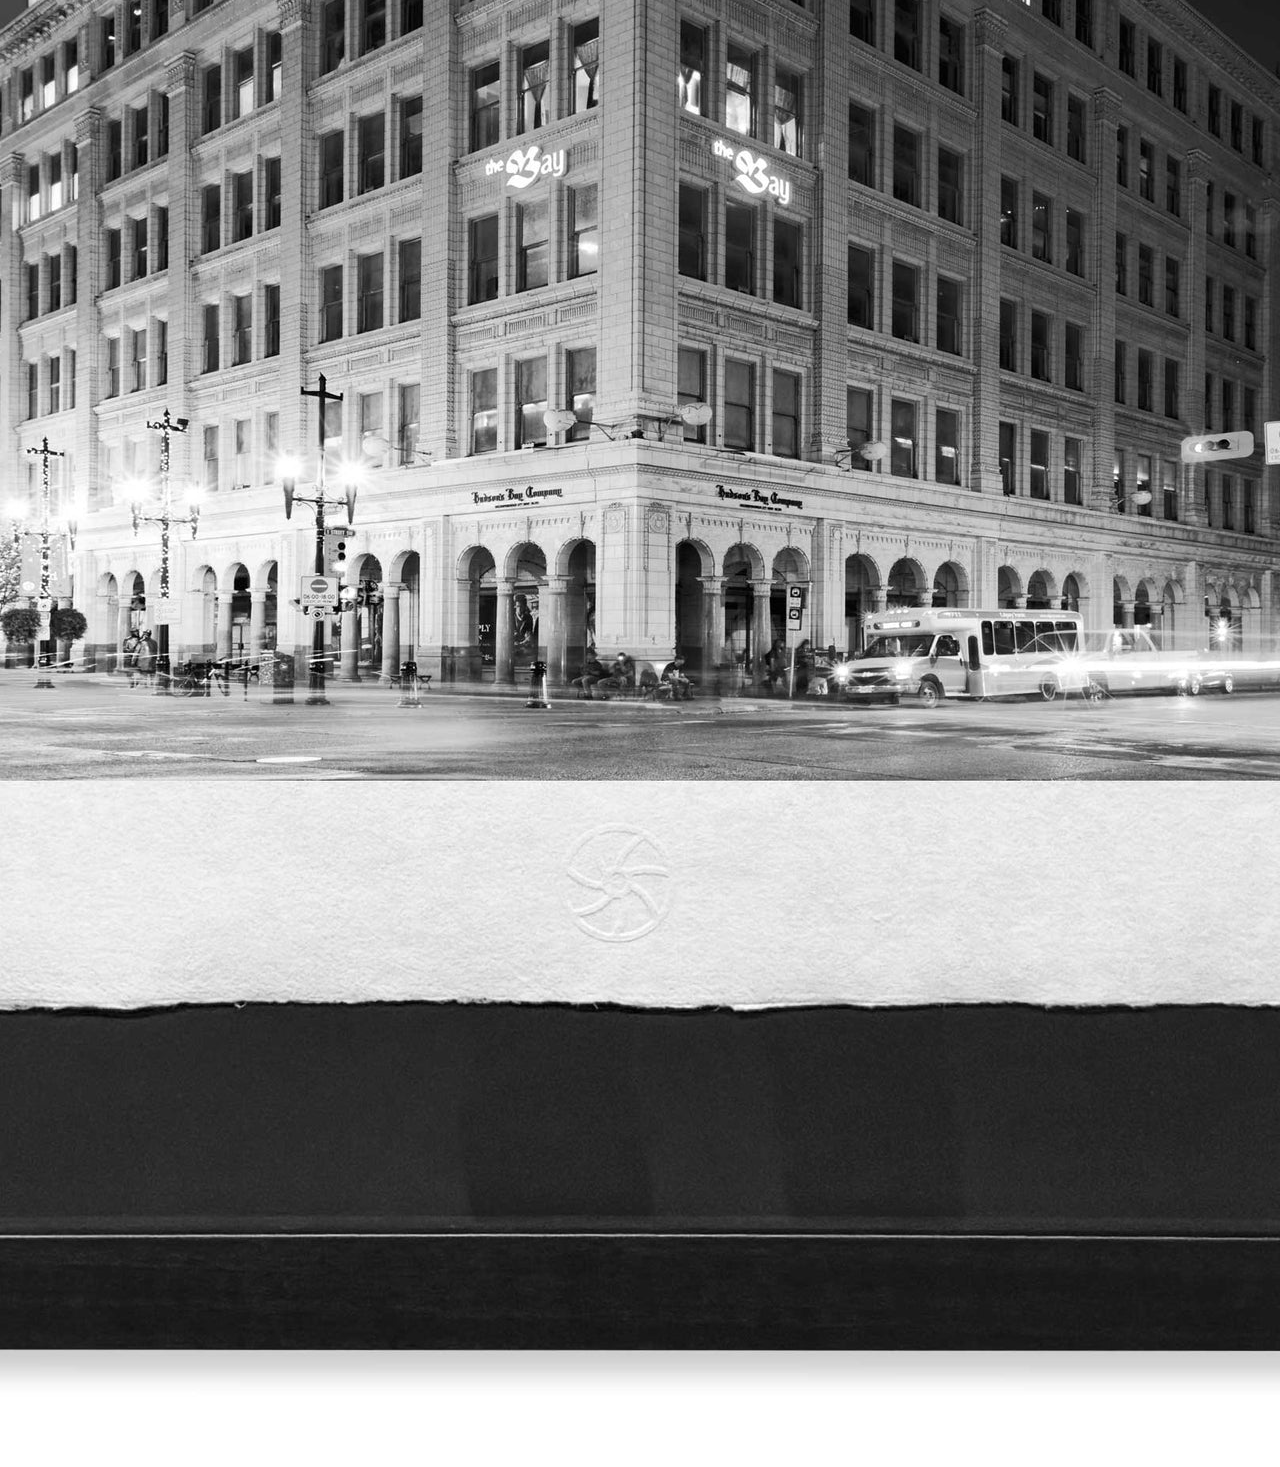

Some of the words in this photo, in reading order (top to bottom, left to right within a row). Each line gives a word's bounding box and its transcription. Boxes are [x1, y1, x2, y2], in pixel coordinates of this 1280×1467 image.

[485, 158, 504, 176] the
[505, 145, 564, 189] Bay
[713, 139, 734, 160] the
[735, 150, 790, 204] Bay
[471, 491, 505, 506] Hudson's
[505, 488, 524, 501] Bay
[525, 485, 563, 499] Company
[716, 484, 751, 501] Hudson's
[751, 489, 769, 505] Bay
[770, 492, 803, 509] Company
